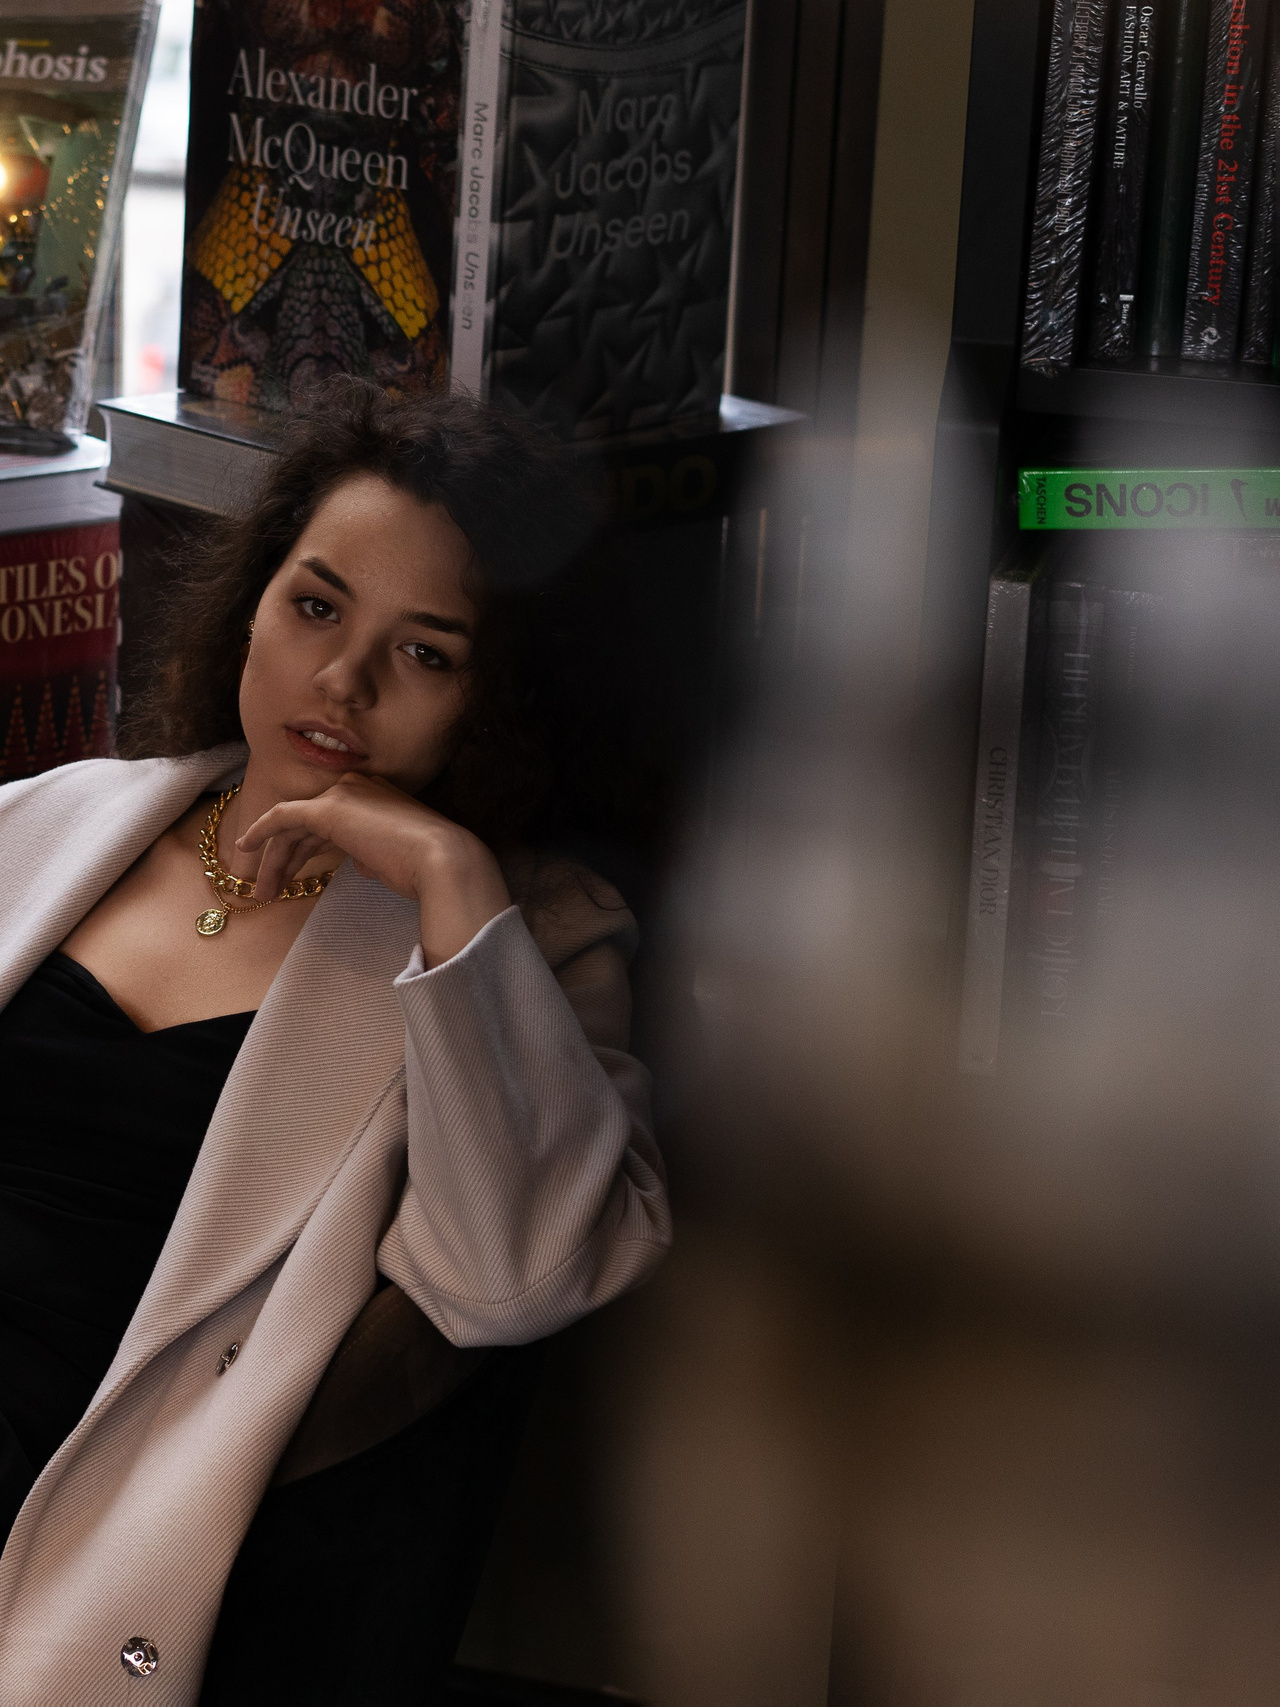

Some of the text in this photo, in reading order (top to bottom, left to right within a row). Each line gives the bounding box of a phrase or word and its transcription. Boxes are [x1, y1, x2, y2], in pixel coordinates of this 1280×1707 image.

[1132, 6, 1154, 109] Oscar Carvallo
[227, 47, 419, 121] Alexander
[1117, 101, 1129, 111] &
[1118, 70, 1131, 97] ART
[1224, 83, 1245, 105] in
[470, 103, 488, 159] Marc
[578, 90, 678, 137] Marc
[1219, 114, 1243, 150] the
[227, 112, 409, 191] McQueen
[1112, 115, 1128, 169] NATURE
[555, 140, 692, 199] Jacobs
[1214, 158, 1239, 205] 21st
[252, 184, 377, 252] Unseen
[549, 208, 690, 259] Unseen
[1200, 213, 1234, 306] Century
[1120, 303, 1130, 324] Skira
[1035, 477, 1047, 525] TASCHEN
[1064, 482, 1210, 518] ICONS
[978, 747, 1008, 916] CHRISTIAN DIOR
